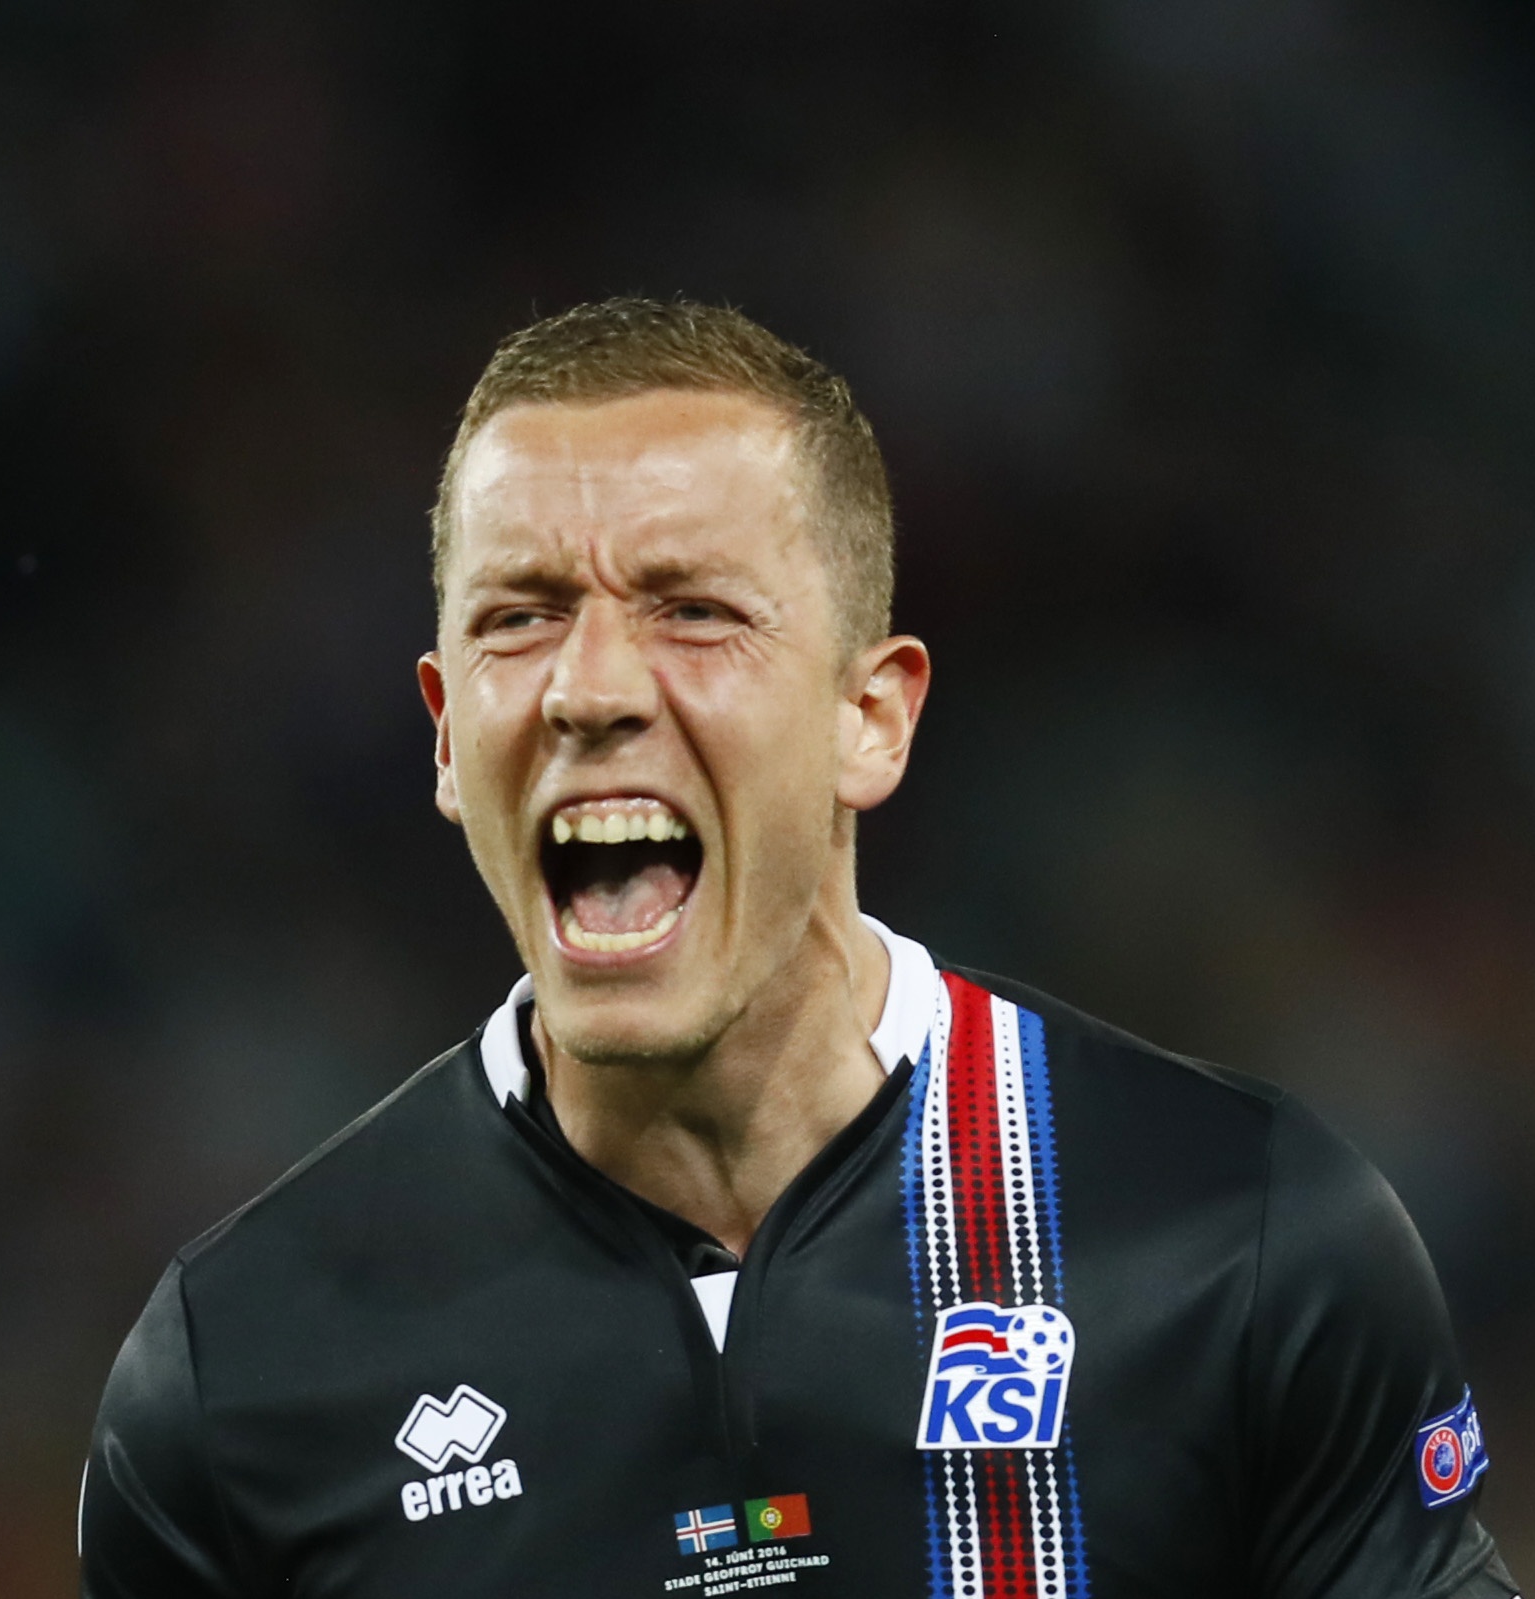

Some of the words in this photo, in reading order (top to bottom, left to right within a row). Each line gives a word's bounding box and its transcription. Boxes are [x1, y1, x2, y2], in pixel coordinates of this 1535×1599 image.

[757, 1546, 787, 1559] 2016
[665, 1575, 701, 1591] STADE
[703, 1563, 763, 1583] GEOFFROY
[766, 1555, 830, 1571] GUICHARD
